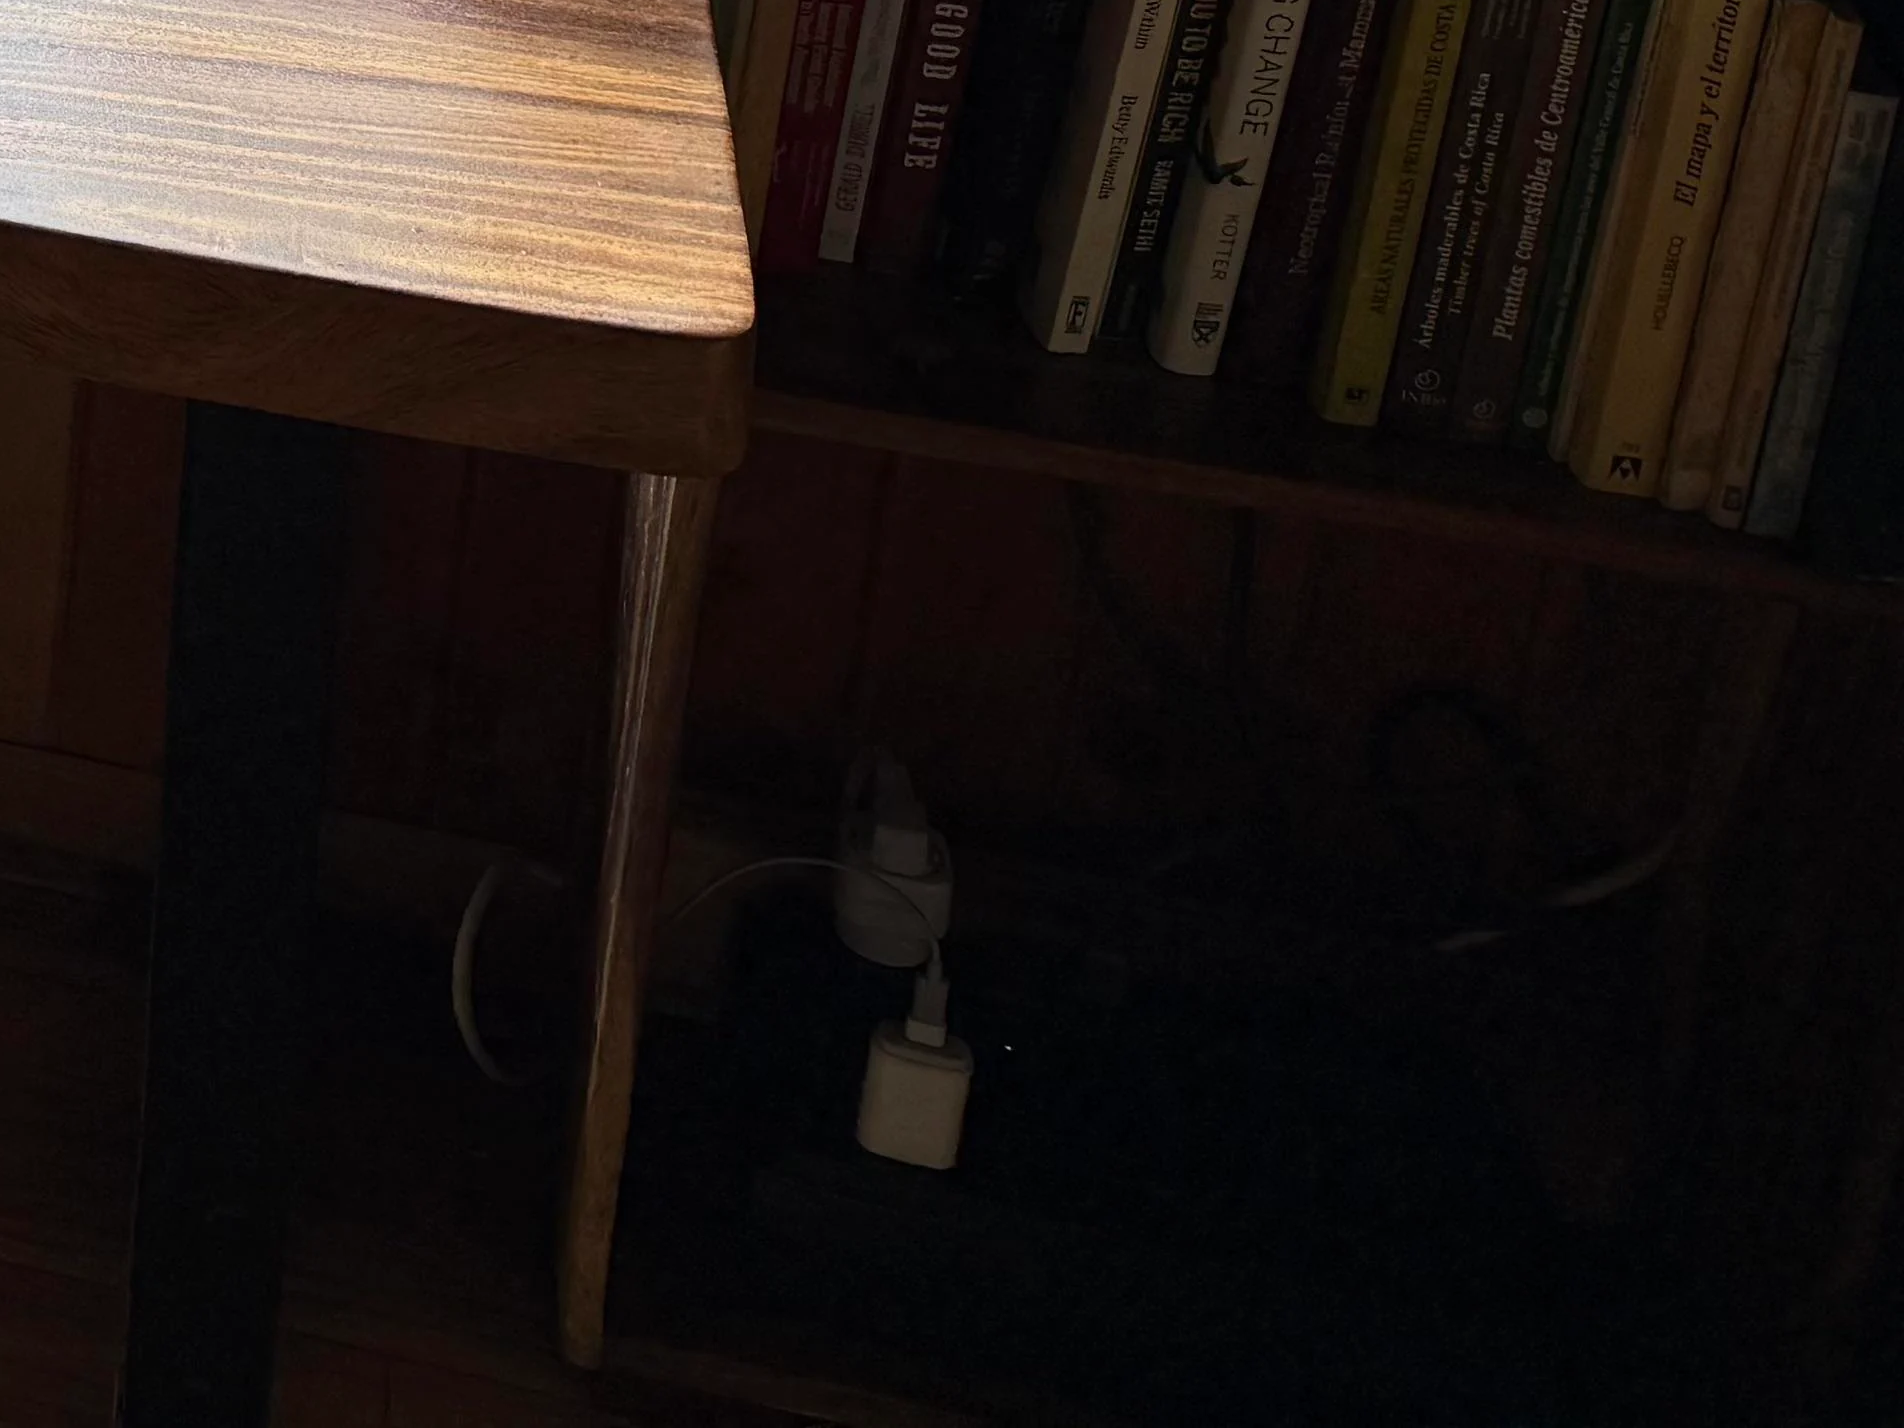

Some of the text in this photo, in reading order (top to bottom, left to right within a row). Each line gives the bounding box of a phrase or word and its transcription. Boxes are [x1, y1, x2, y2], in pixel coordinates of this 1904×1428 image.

[922, 0, 970, 81] GOOD
[1180, 22, 1212, 55] TO
[1430, 4, 1457, 52] COSTA
[1172, 56, 1204, 88] BE
[1238, 13, 1295, 137] CHANGE
[1424, 53, 1444, 76] DE
[1699, 75, 1723, 99] el
[1111, 94, 1139, 133] Betty
[1469, 72, 1492, 108] Rica
[1699, 99, 1720, 121] y
[903, 101, 950, 172] LIFE
[1157, 91, 1196, 144] RICH
[1457, 112, 1483, 160] Costa
[1533, 130, 1560, 153] de
[1452, 164, 1472, 185] de
[1685, 122, 1713, 179] mapa
[1514, 156, 1554, 261] comestibles
[1672, 180, 1697, 208] El
[1288, 170, 1332, 276] Neotropical
[1382, 178, 1415, 265] NATURALES
[1435, 187, 1465, 284] maderables
[1210, 212, 1241, 282] KOTTER
[1491, 263, 1530, 342] Plantas
